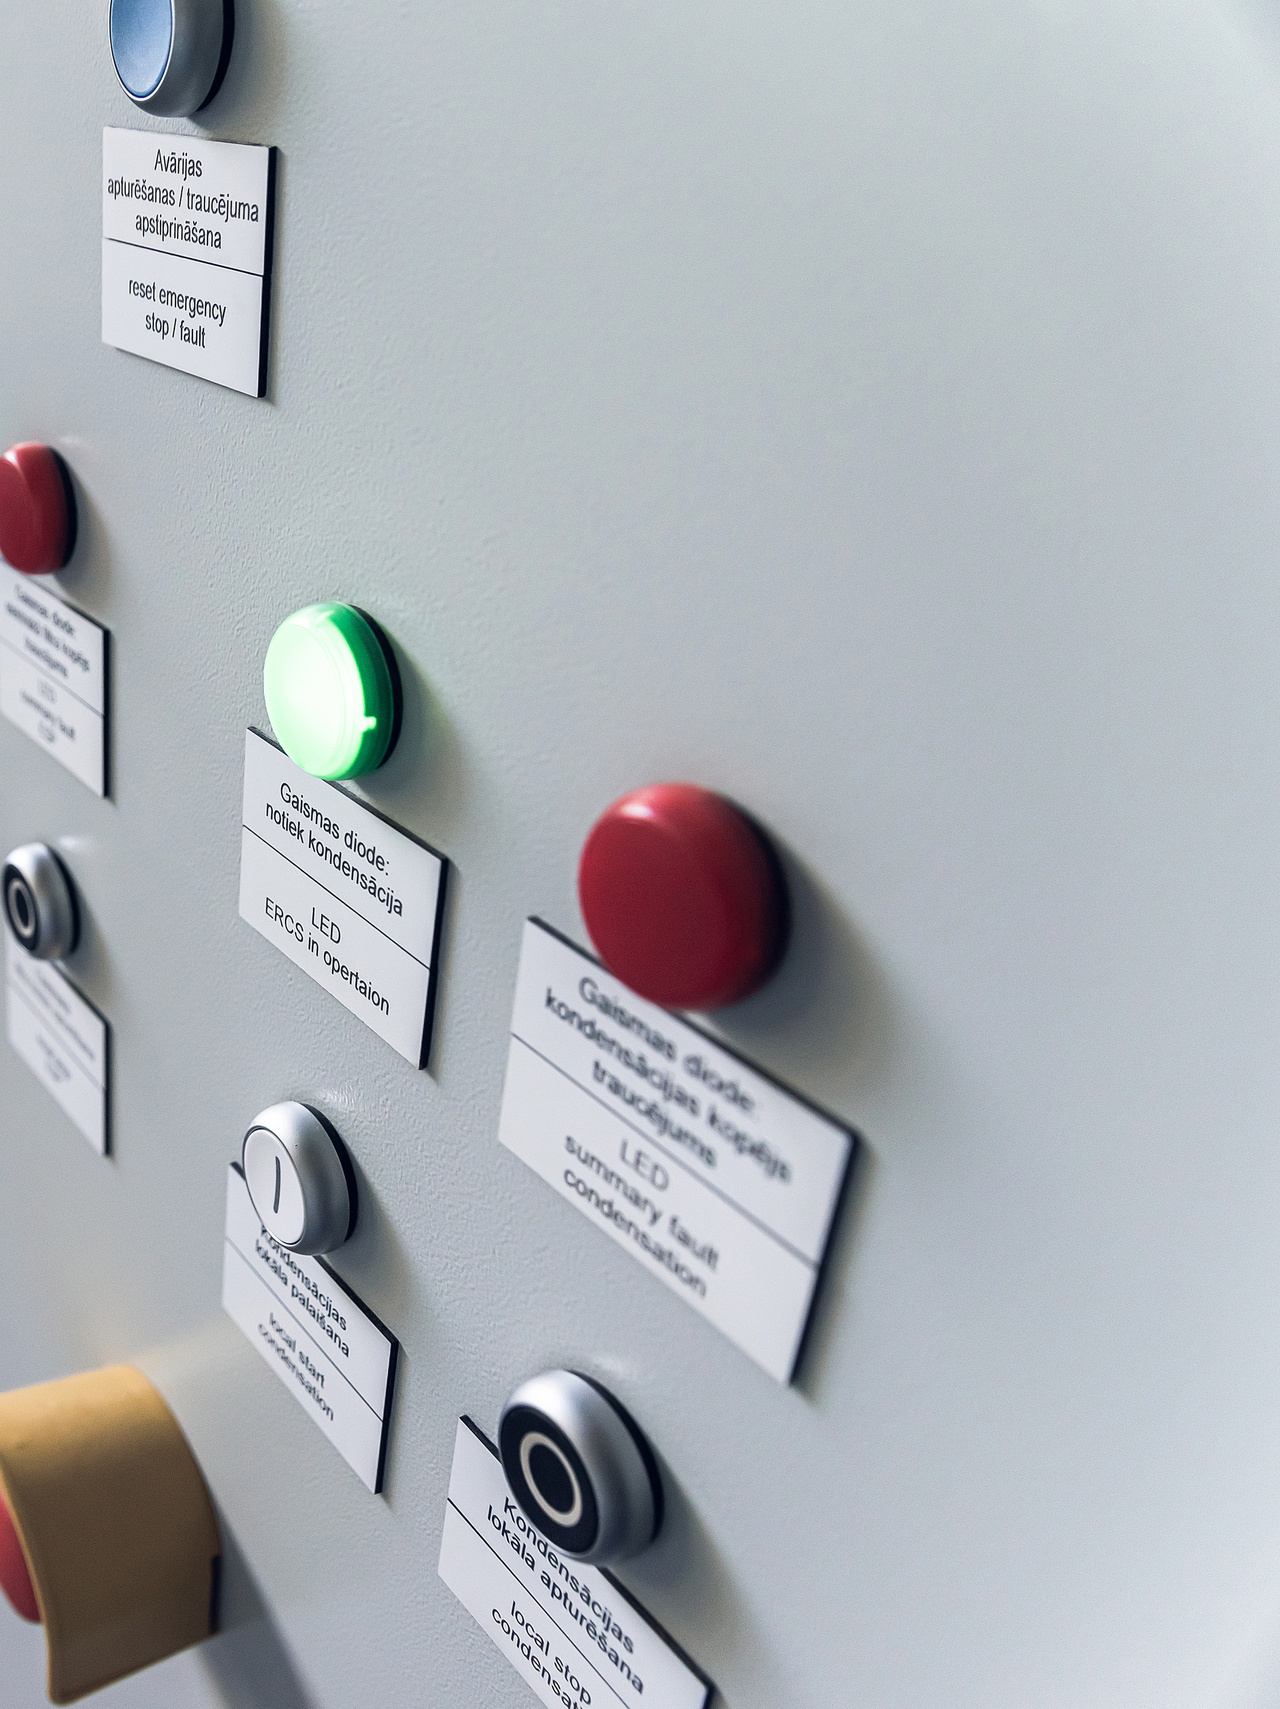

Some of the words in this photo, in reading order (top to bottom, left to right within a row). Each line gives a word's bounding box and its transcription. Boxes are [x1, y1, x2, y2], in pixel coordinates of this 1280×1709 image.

[107, 176, 176, 208] apturēšanas
[178, 185, 184, 208] /
[186, 188, 260, 223] traucējuma
[154, 149, 203, 182] Avārijas
[135, 214, 222, 250] apstiprināšana
[128, 278, 156, 302] reset
[159, 288, 227, 328] emergency
[145, 312, 169, 340] stop
[172, 317, 177, 338] /
[180, 321, 206, 348] fault
[265, 802, 305, 845] notiek
[308, 829, 404, 918] kondensācija
[280, 782, 340, 840] Gaismas
[344, 830, 391, 877] diode:
[265, 897, 304, 943] ERCS
[308, 932, 319, 957] in
[323, 945, 391, 1016] opertaion
[311, 906, 342, 946] LED
[578, 976, 677, 1062] Gaismas
[565, 1134, 663, 1227] summary
[669, 1214, 719, 1273] fault
[620, 1137, 670, 1193] LED
[563, 1168, 708, 1299] condensation
[299, 1350, 325, 1389] start
[487, 1504, 536, 1572] lokāla
[540, 1569, 644, 1695] apturēšana
[504, 1496, 634, 1655] Kondensācijas
[510, 1600, 550, 1657] local
[554, 1655, 592, 1706] stop
